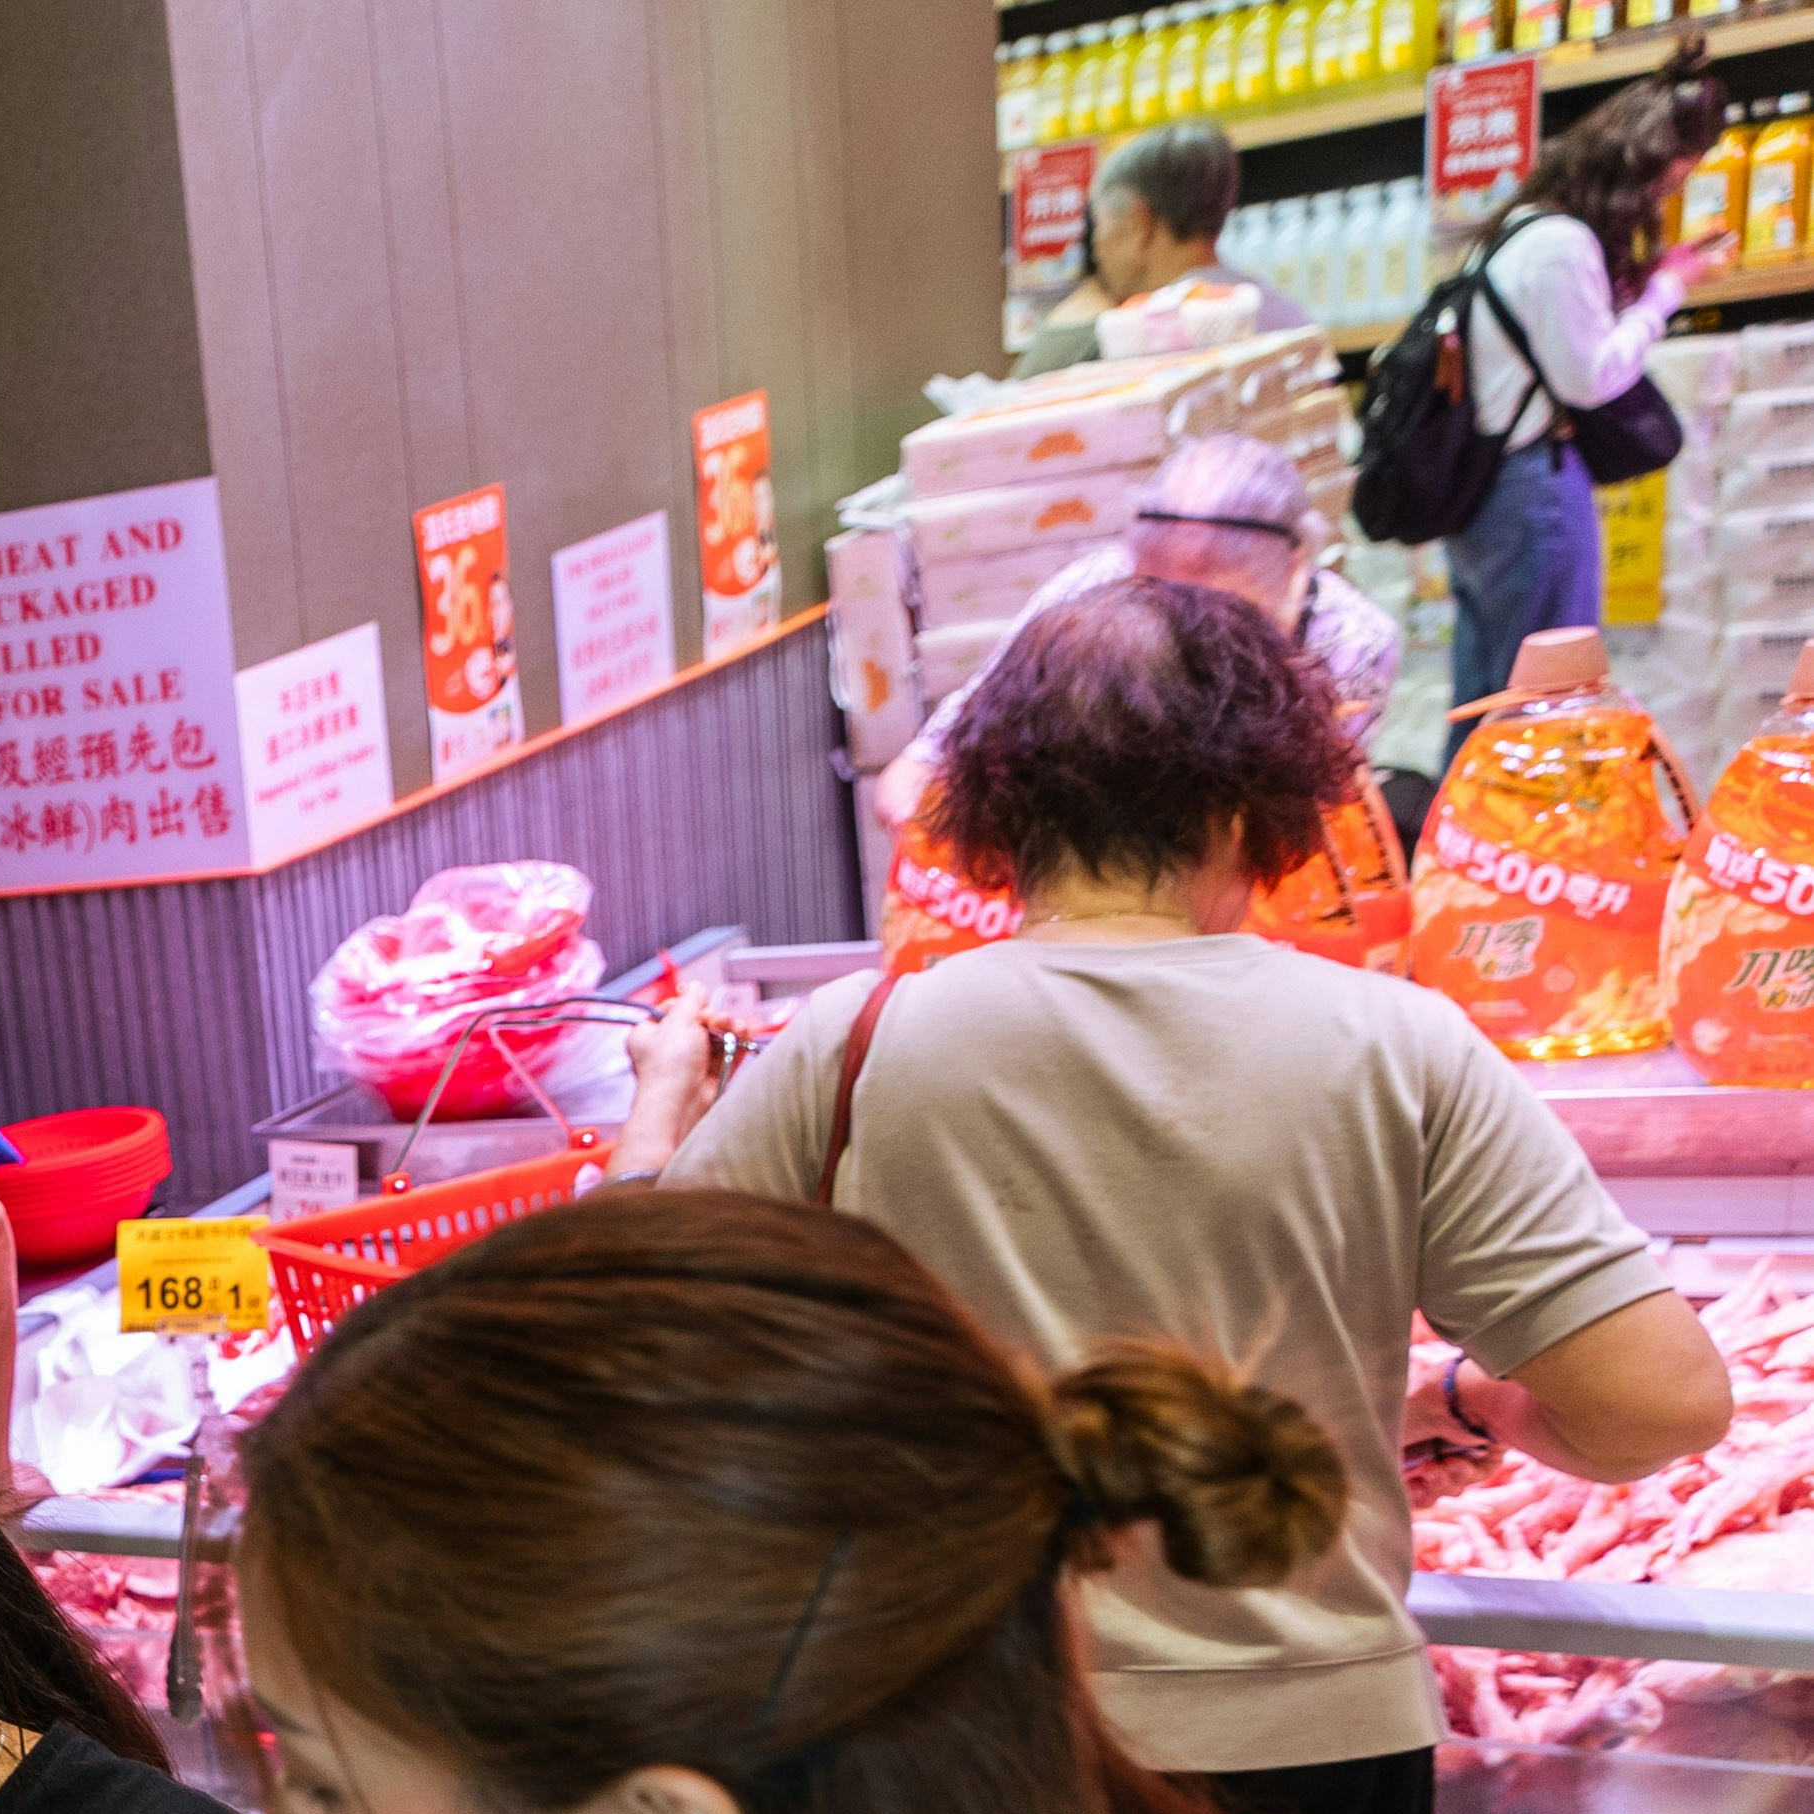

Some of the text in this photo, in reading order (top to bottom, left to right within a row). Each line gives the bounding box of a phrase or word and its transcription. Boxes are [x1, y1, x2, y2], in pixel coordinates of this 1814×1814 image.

[99, 517, 184, 561] AND
[81, 668, 184, 711] SALE
[137, 1276, 203, 1311] 168
